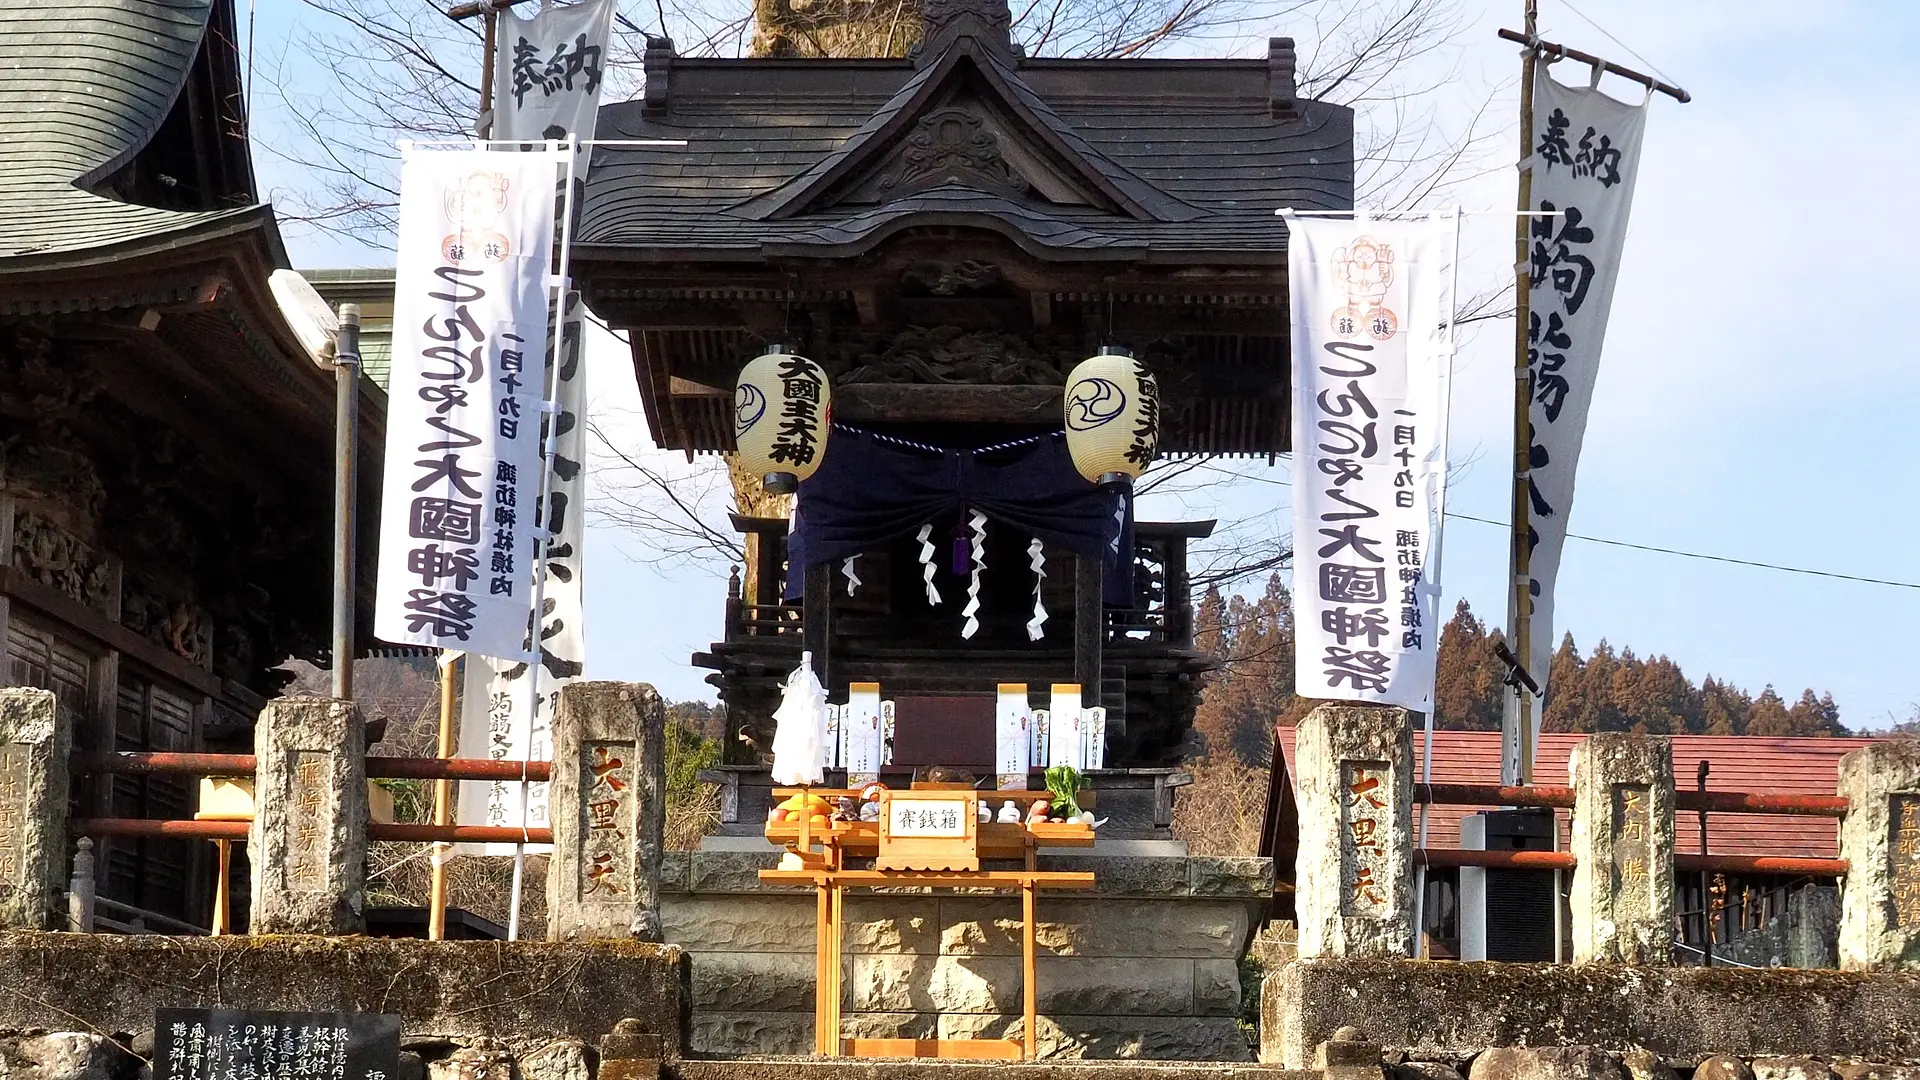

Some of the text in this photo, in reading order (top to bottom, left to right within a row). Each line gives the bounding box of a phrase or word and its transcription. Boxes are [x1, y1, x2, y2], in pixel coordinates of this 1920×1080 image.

[511, 33, 602, 111] 奉納
[1535, 107, 1622, 189] 奉納
[768, 357, 823, 467] 大國主大神
[899, 809, 958, 829] 賽銭箱
